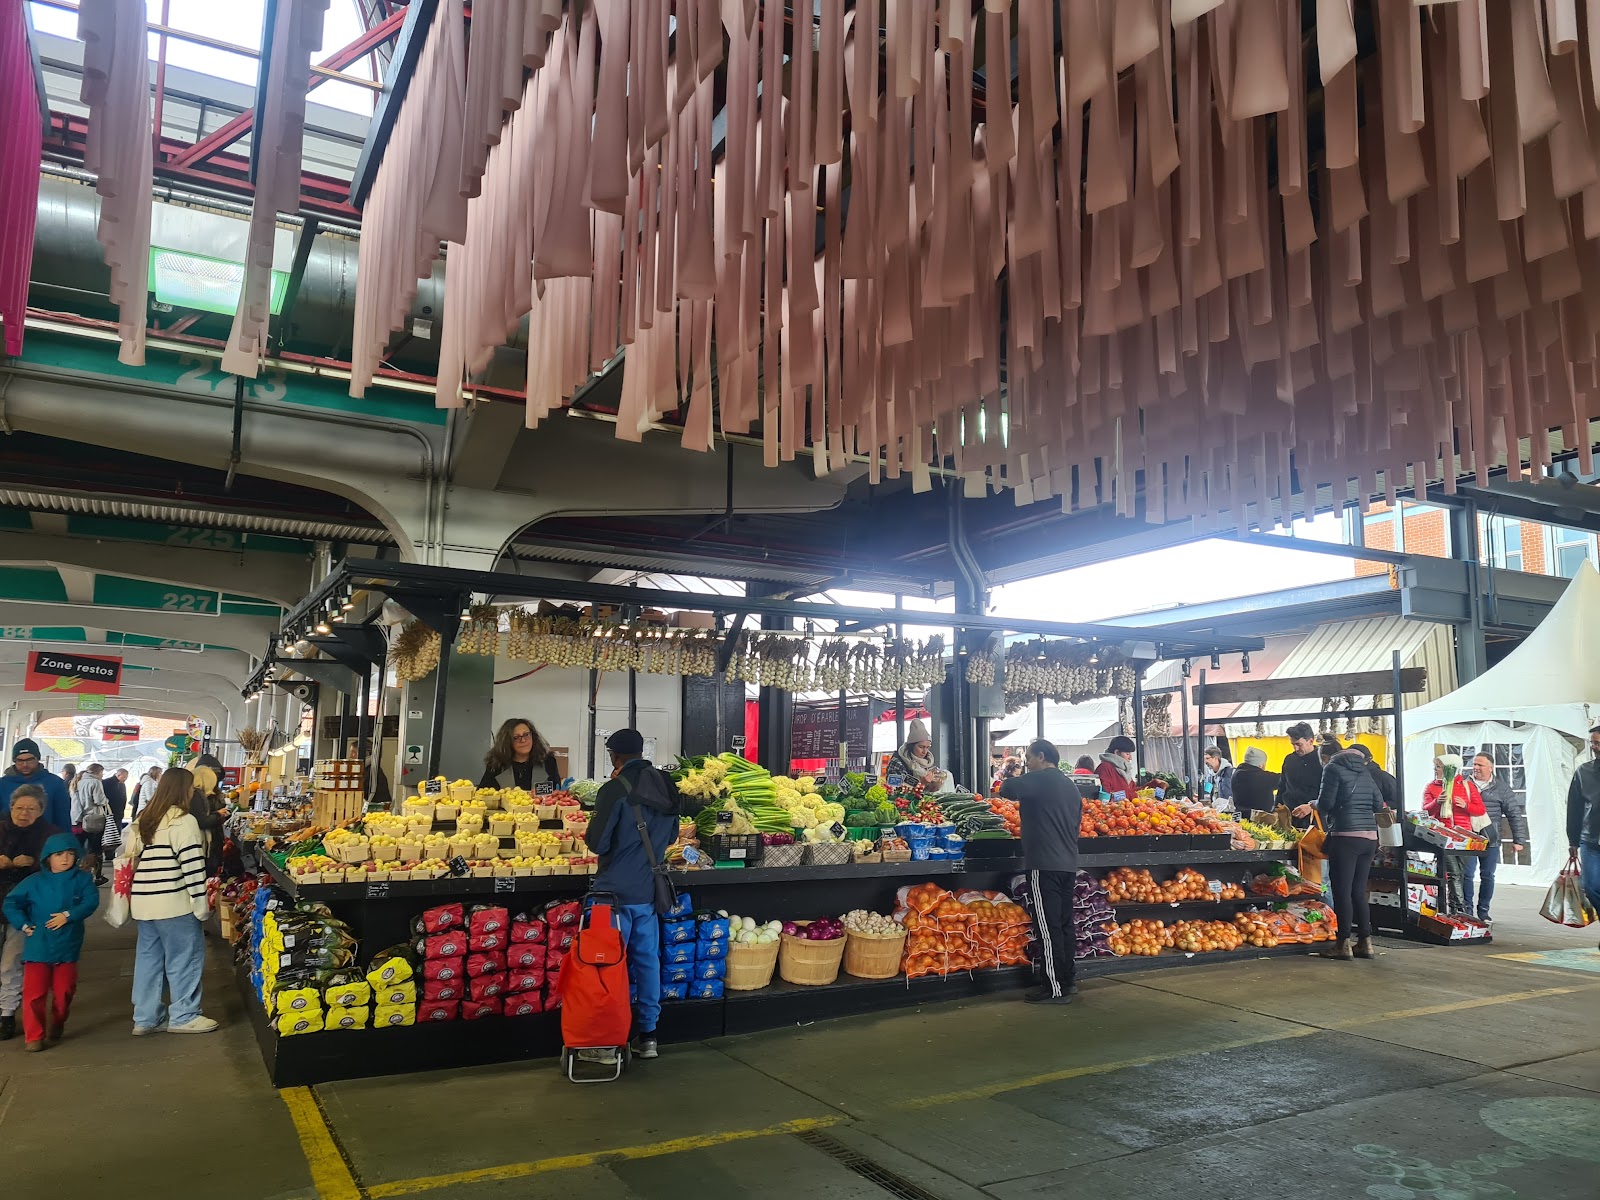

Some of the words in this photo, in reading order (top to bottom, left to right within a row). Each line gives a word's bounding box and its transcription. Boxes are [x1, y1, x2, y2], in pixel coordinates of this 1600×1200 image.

[162, 593, 212, 612] 227
[40, 657, 72, 670] Zone
[76, 664, 114, 676] restos
